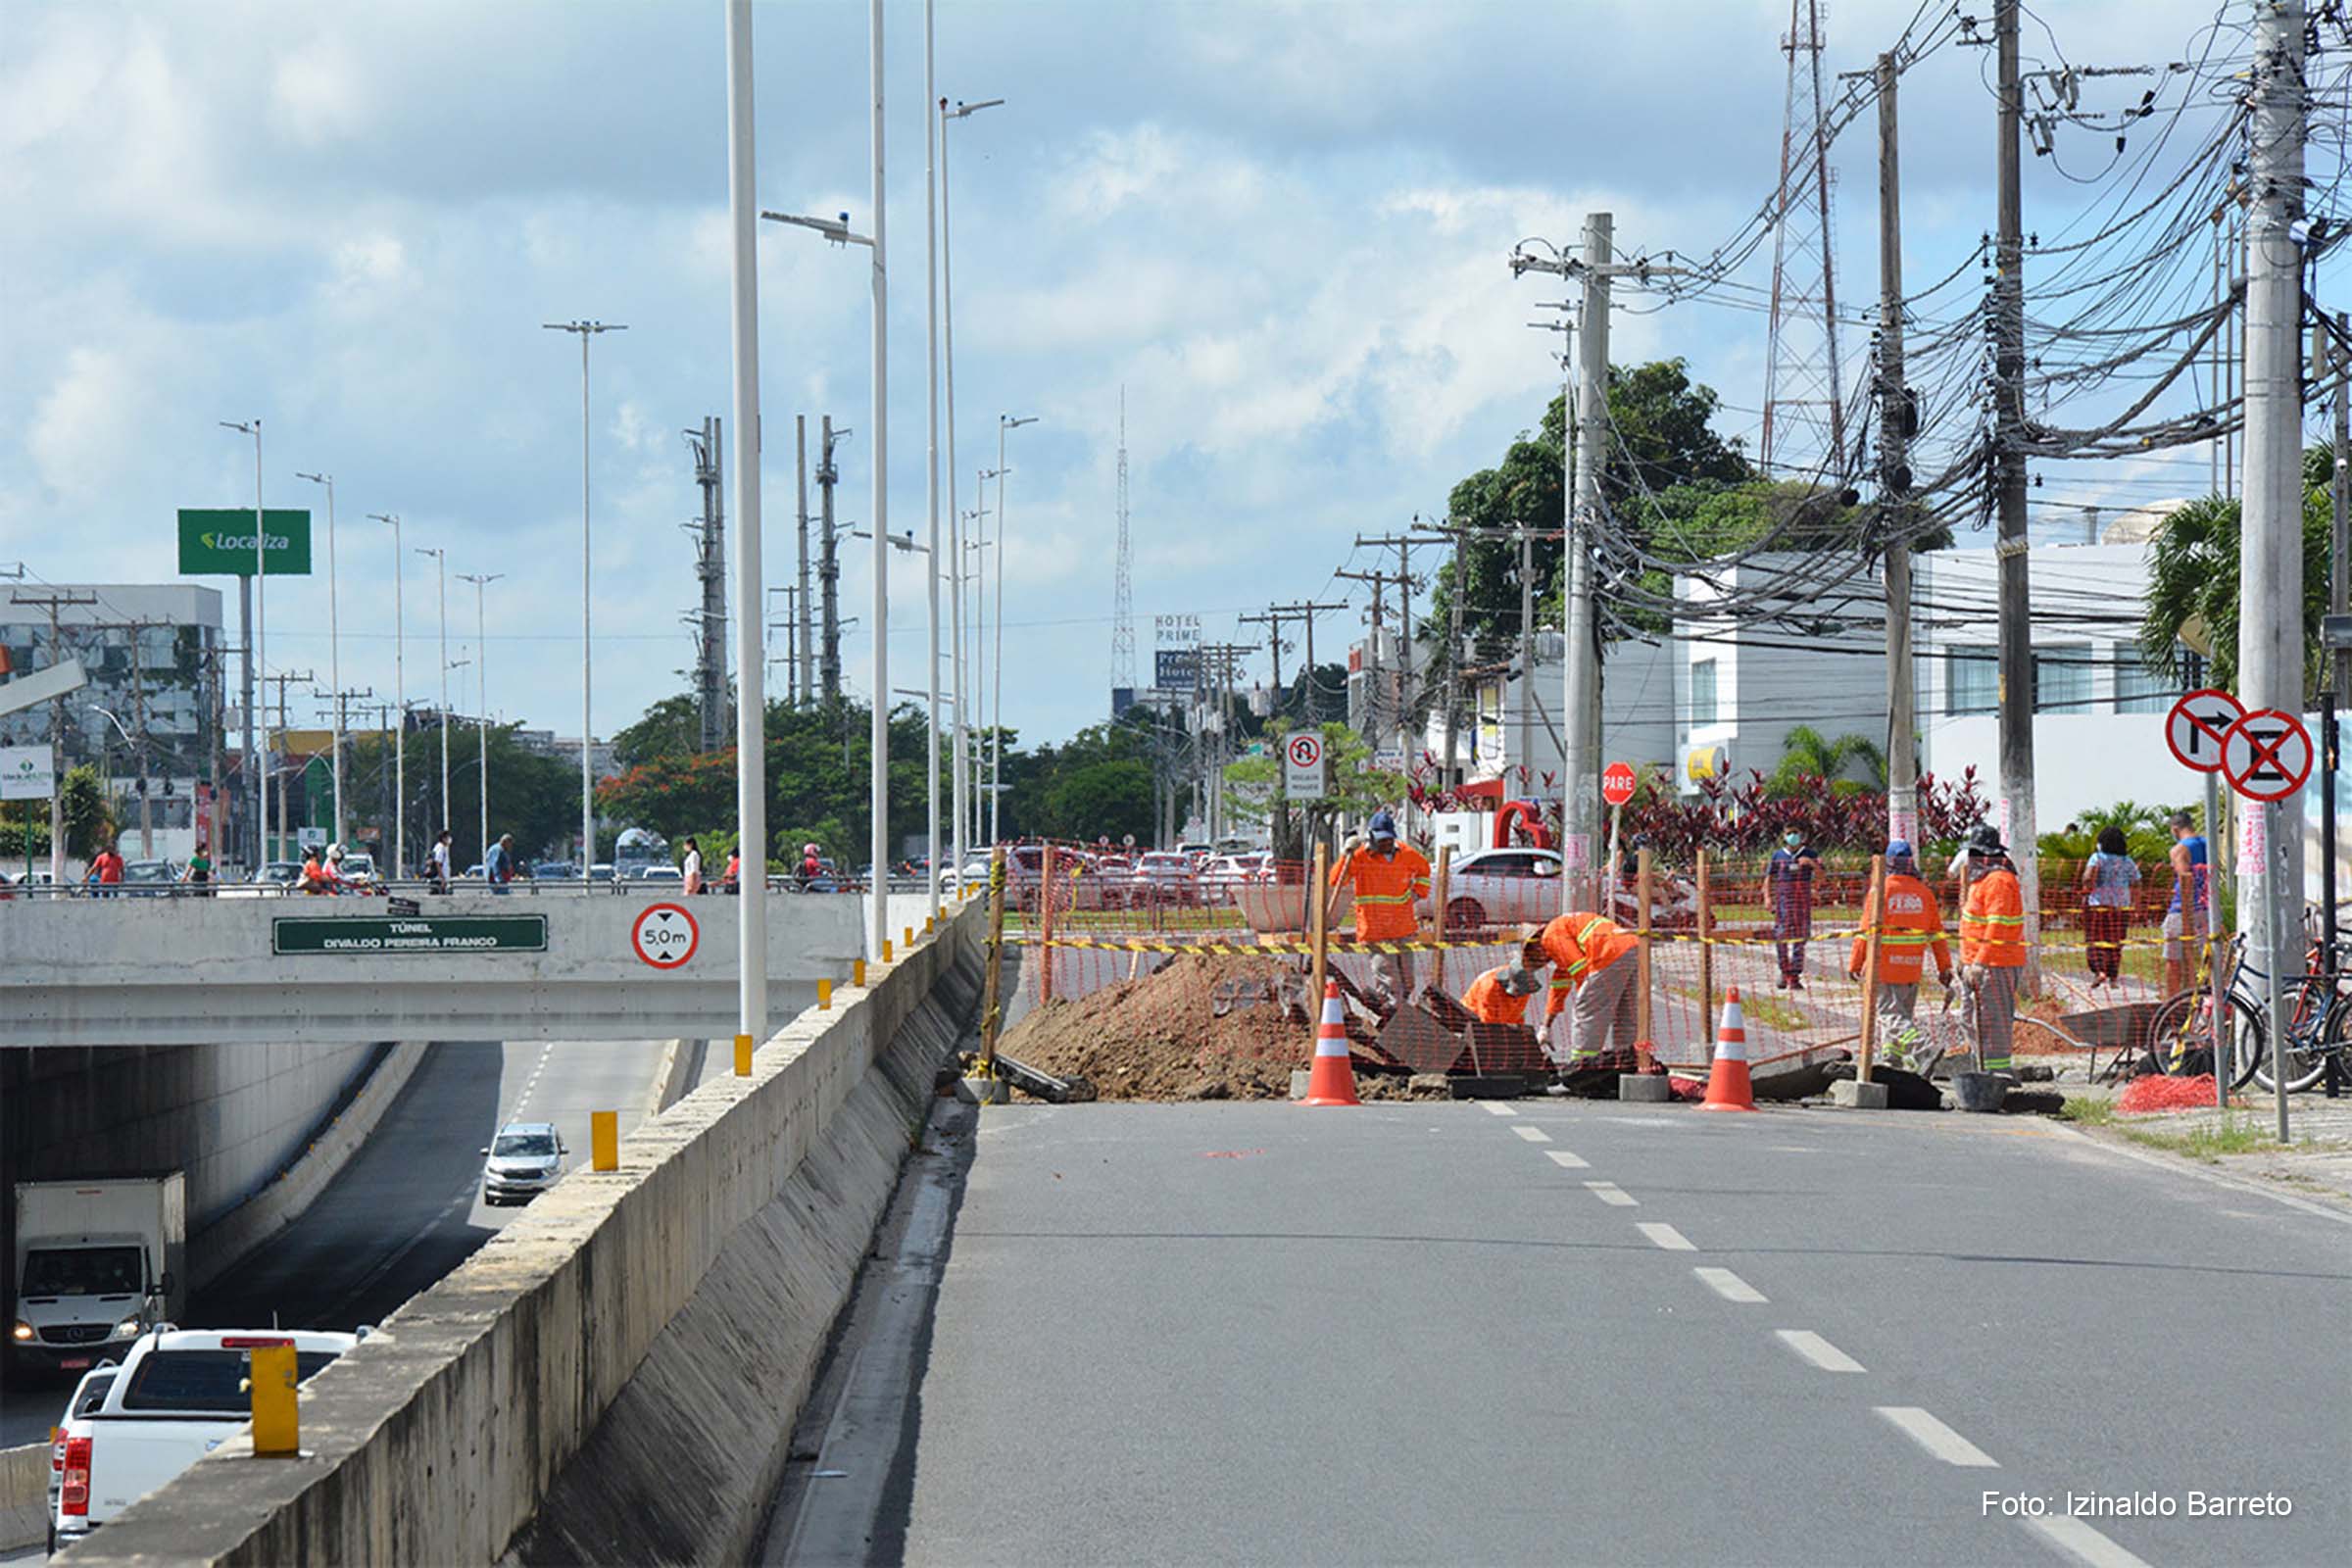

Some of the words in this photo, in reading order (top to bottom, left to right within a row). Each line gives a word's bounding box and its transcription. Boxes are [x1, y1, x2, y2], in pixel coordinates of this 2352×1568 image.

[217, 532, 289, 550] Locaiza
[1156, 615, 1200, 627] HOTEL
[1156, 629, 1200, 642] PRIME
[1603, 775, 1633, 791] PARE
[389, 921, 432, 933] TÚNEL
[323, 938, 380, 949] DIVALDO
[383, 937, 440, 948] PEREIRA
[443, 936, 498, 947] FRANCO
